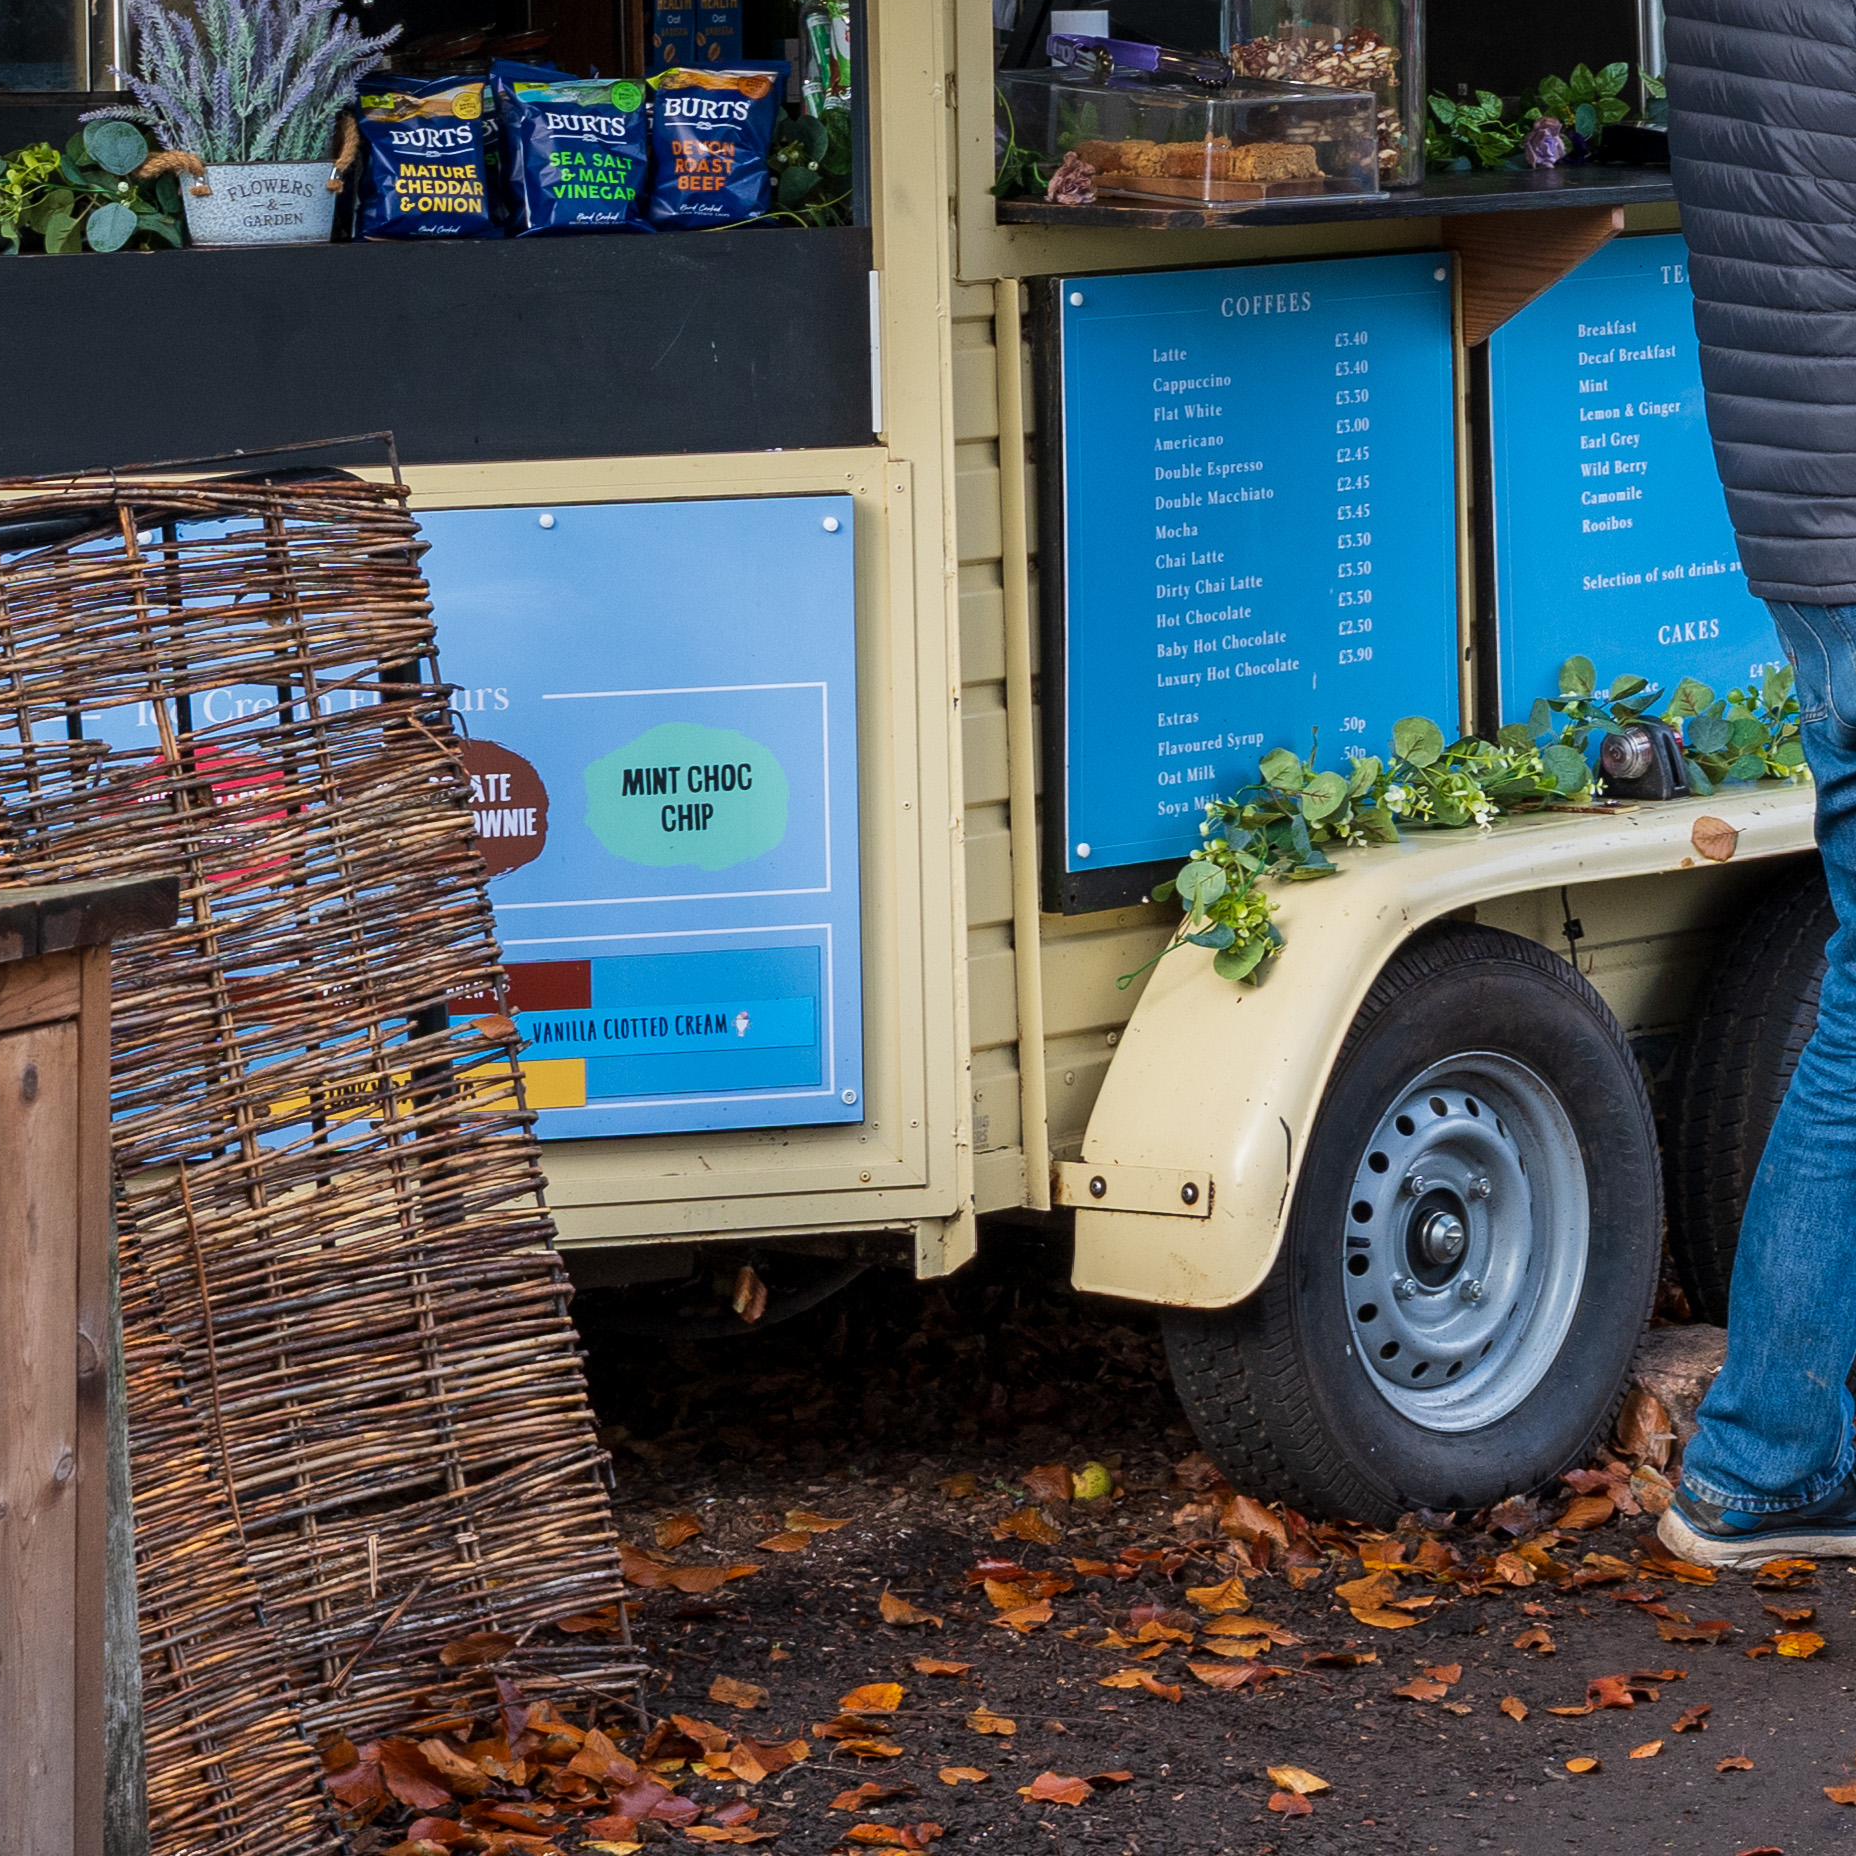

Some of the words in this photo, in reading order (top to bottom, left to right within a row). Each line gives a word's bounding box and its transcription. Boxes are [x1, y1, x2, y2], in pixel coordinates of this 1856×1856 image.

[663, 97, 750, 121] BURTS
[545, 111, 627, 137] BURTS
[389, 125, 474, 148] BURTS
[549, 151, 586, 167] SEA
[592, 153, 632, 171] SALT
[674, 158, 736, 174] ROAST
[399, 163, 478, 179] MATURE
[560, 168, 576, 182] &
[579, 169, 627, 185] MALT
[227, 178, 315, 202] FLOWERS
[395, 179, 485, 196] CHEDDAR
[553, 184, 636, 202] VINEGAR
[677, 176, 727, 192] BEEF
[266, 198, 279, 211] &
[399, 196, 415, 212] &
[417, 197, 483, 213] ONION
[243, 212, 304, 228] GARDEN
[1661, 264, 1689, 284] TE
[1221, 291, 1312, 318] COFFEES
[1578, 320, 1637, 337] Breakfast
[1334, 331, 1368, 347] £3.40
[1153, 348, 1187, 363] Latte
[1579, 349, 1615, 366] Decaf
[1619, 344, 1676, 362] Breakfast
[1335, 360, 1369, 376] £3.40
[1153, 374, 1232, 394] Cappuccino
[1579, 379, 1608, 394] Mint
[1335, 389, 1369, 405] £3.30
[1153, 406, 1179, 422] Flat
[1184, 403, 1223, 419] White
[1580, 407, 1620, 422] Lemon
[1625, 403, 1634, 418] &
[1638, 401, 1681, 418] Ginger
[1336, 417, 1370, 434] £3.00
[1154, 435, 1224, 451] Americano
[1580, 433, 1606, 449] Earl
[1610, 432, 1640, 448] Grey
[1336, 446, 1370, 463] £2.45
[1154, 463, 1202, 481] Double
[1207, 460, 1264, 478] Espresso
[1581, 460, 1610, 477] Wild
[1614, 460, 1648, 475] Berry
[1337, 474, 1370, 492] £2.45
[1155, 492, 1203, 511] Double
[1207, 486, 1274, 505] Macchiato
[1581, 485, 1642, 505] Camomile
[1337, 503, 1371, 521] £3.45
[1155, 522, 1198, 540] Mocha
[1582, 516, 1633, 533] Rooibos
[1337, 532, 1372, 549] £3.30
[1155, 553, 1186, 570] Chai
[1191, 550, 1225, 565] Latte
[1338, 560, 1372, 578] £3.50
[1583, 571, 1641, 590] Selection
[1645, 567, 1658, 583] of
[1662, 564, 1684, 581] soft
[1688, 560, 1726, 577] drinks
[1156, 583, 1191, 600] Dirty
[1195, 578, 1225, 595] Chai
[1230, 575, 1263, 591] Latte
[1338, 589, 1373, 607] £3.50
[1156, 613, 1180, 629] Hot
[1185, 605, 1252, 626] Chocolate
[1338, 618, 1373, 635] £2.50
[1658, 619, 1720, 645] CAKES
[1156, 642, 1189, 659] Baby
[1194, 638, 1217, 654] Hot
[1222, 630, 1287, 650] Chocolate
[1339, 646, 1373, 665] £3.90
[1157, 672, 1202, 688] Luxury
[1207, 666, 1230, 681] Hot
[1235, 658, 1300, 678] Chocolate
[203, 688, 332, 726] Crem
[1157, 711, 1200, 727] Extras
[1339, 716, 1366, 733] .50p
[1158, 735, 1223, 757] Flavoured
[1227, 732, 1264, 750] Syrup
[621, 765, 681, 797] MINT
[687, 762, 753, 793] CHOC
[1158, 771, 1182, 786] Oat
[1186, 764, 1216, 782] Milk
[660, 802, 715, 833] CHIP
[1158, 800, 1189, 817] Soya
[532, 1017, 597, 1044] VANILLA
[602, 1015, 670, 1040] CLOTTED
[675, 1012, 729, 1037] CREAM
